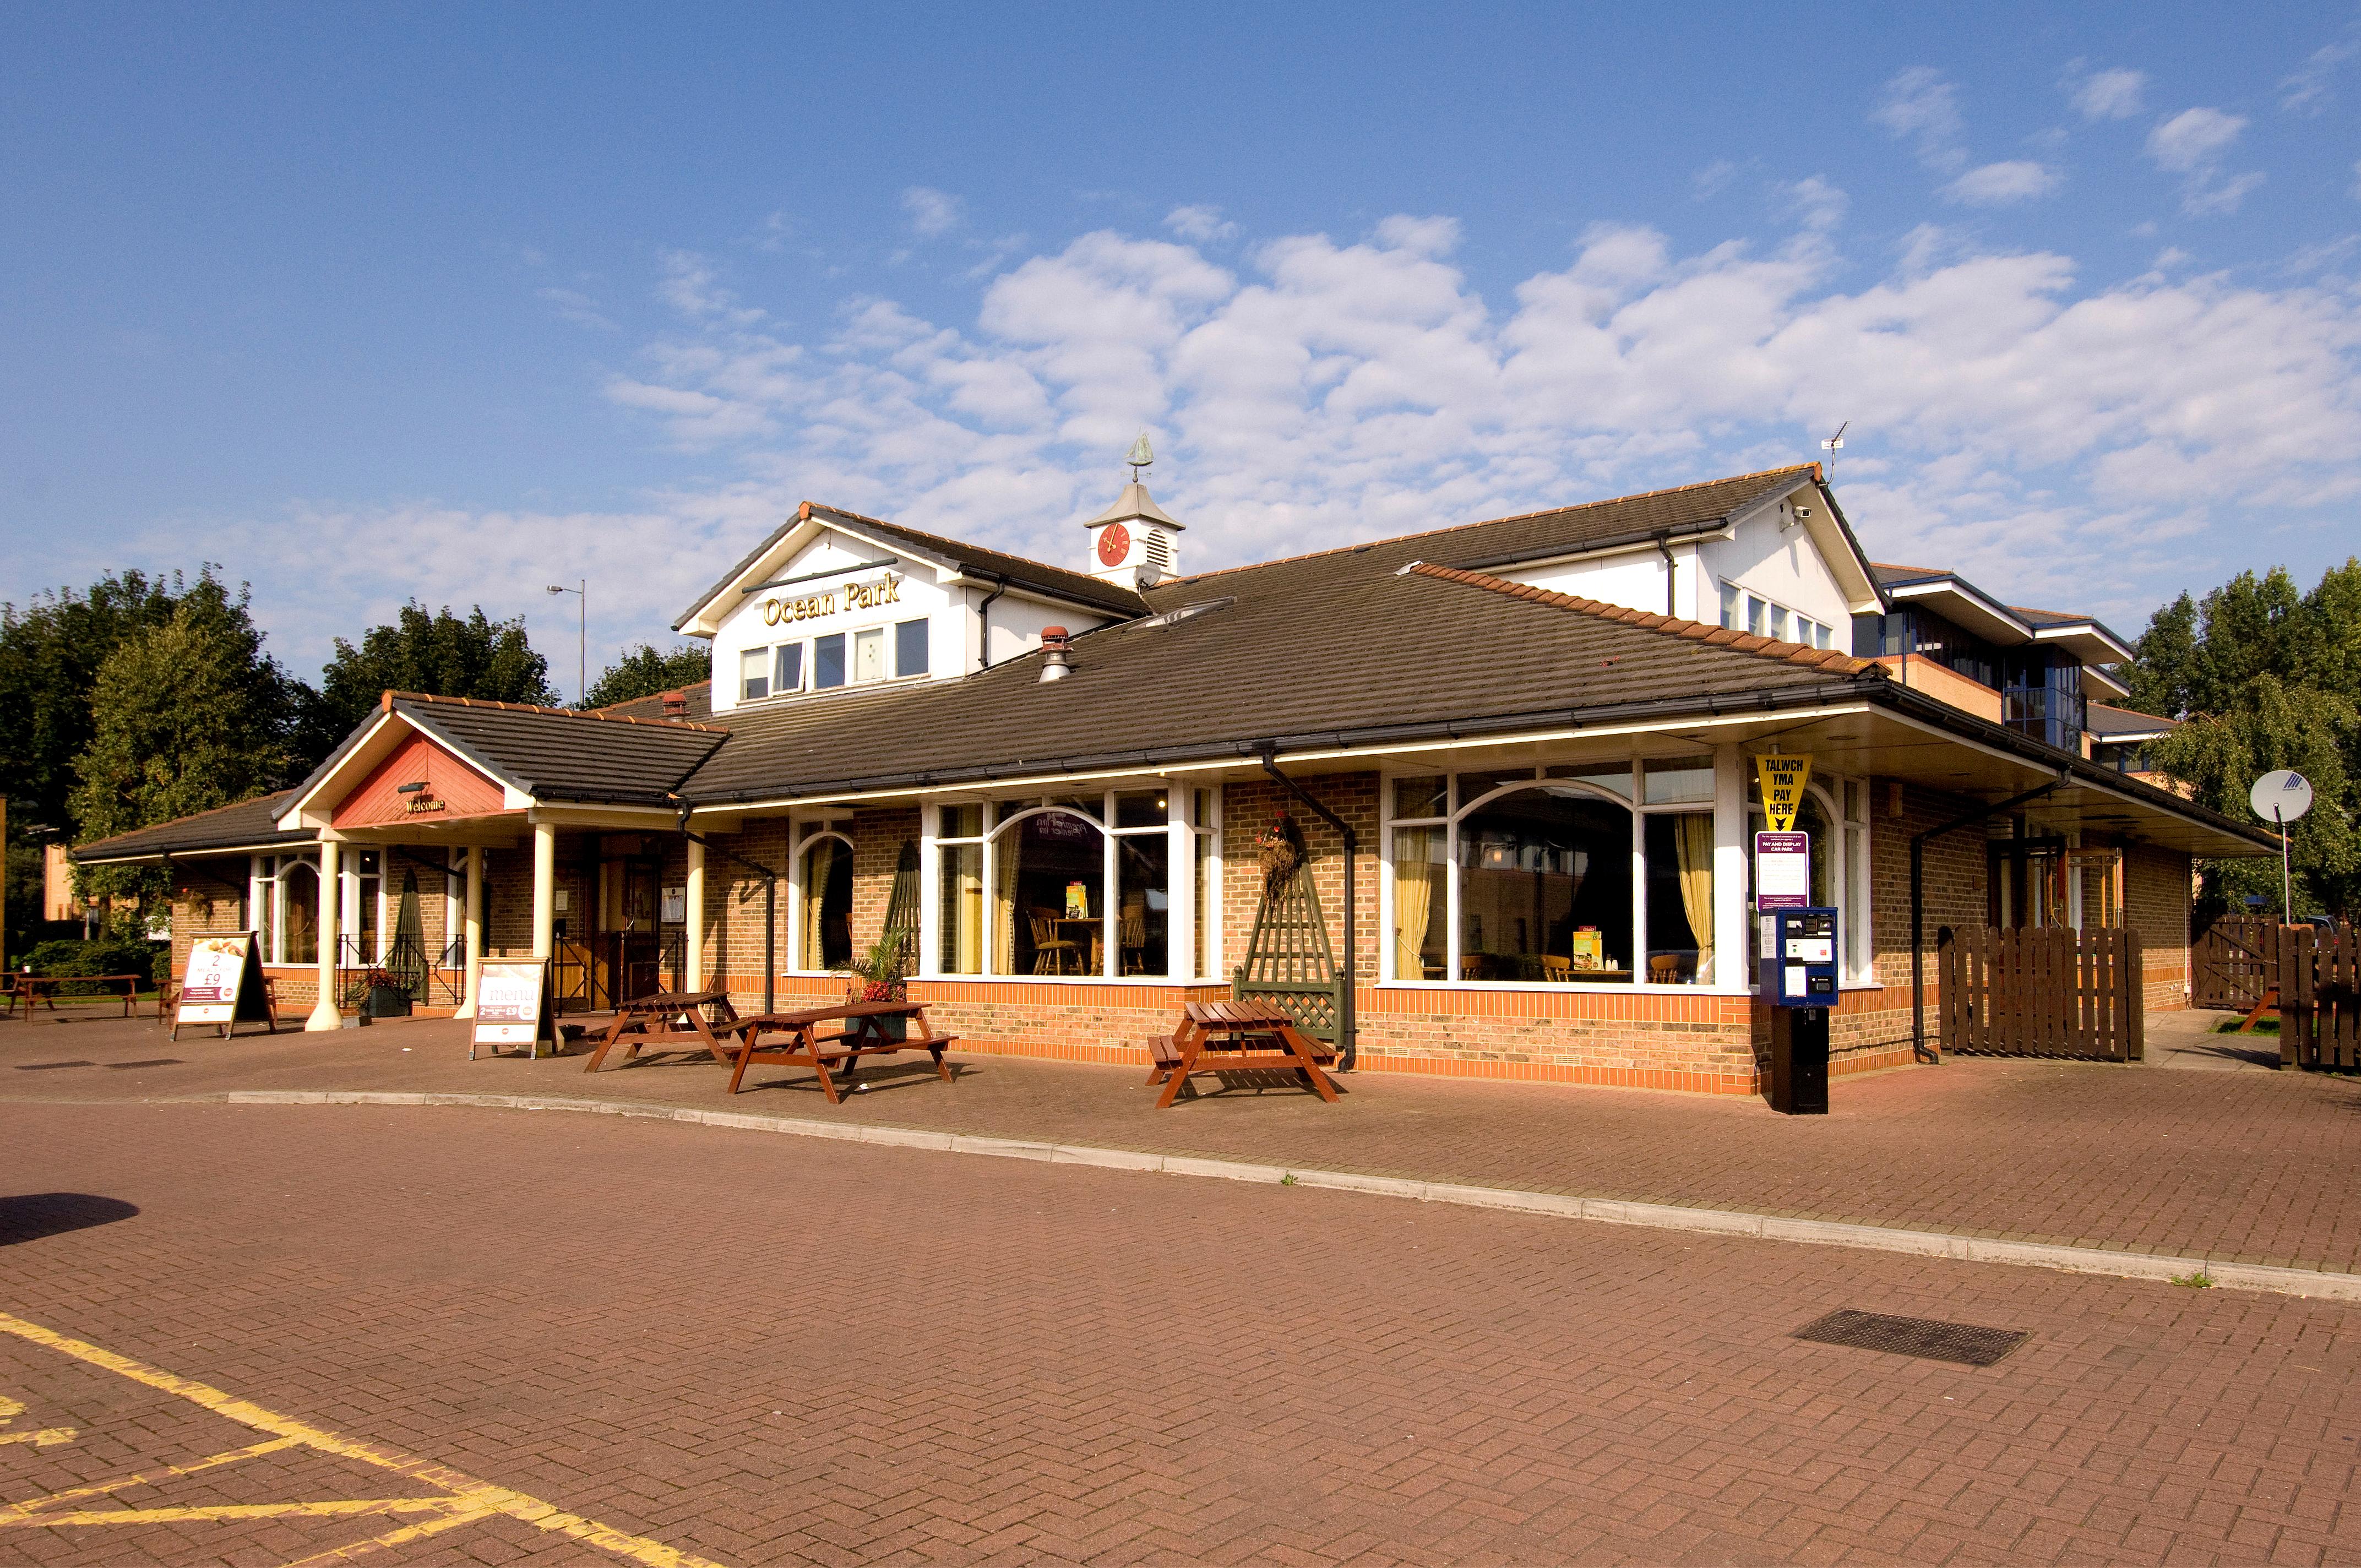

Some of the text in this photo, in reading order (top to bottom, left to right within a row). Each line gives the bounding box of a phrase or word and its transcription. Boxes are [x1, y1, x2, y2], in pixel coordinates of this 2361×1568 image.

[764, 571, 900, 626] Ocean Park
[1765, 759, 1803, 771] TALWCH
[1773, 774, 1793, 785] YMA
[1774, 789, 1791, 801] PAY
[406, 798, 444, 813] Welcome
[1769, 803, 1793, 815] HERE
[213, 955, 220, 966] 2
[204, 973, 220, 985] £9
[489, 990, 534, 1000] menu
[480, 1006, 486, 1015] 2
[506, 1006, 518, 1015] £9
